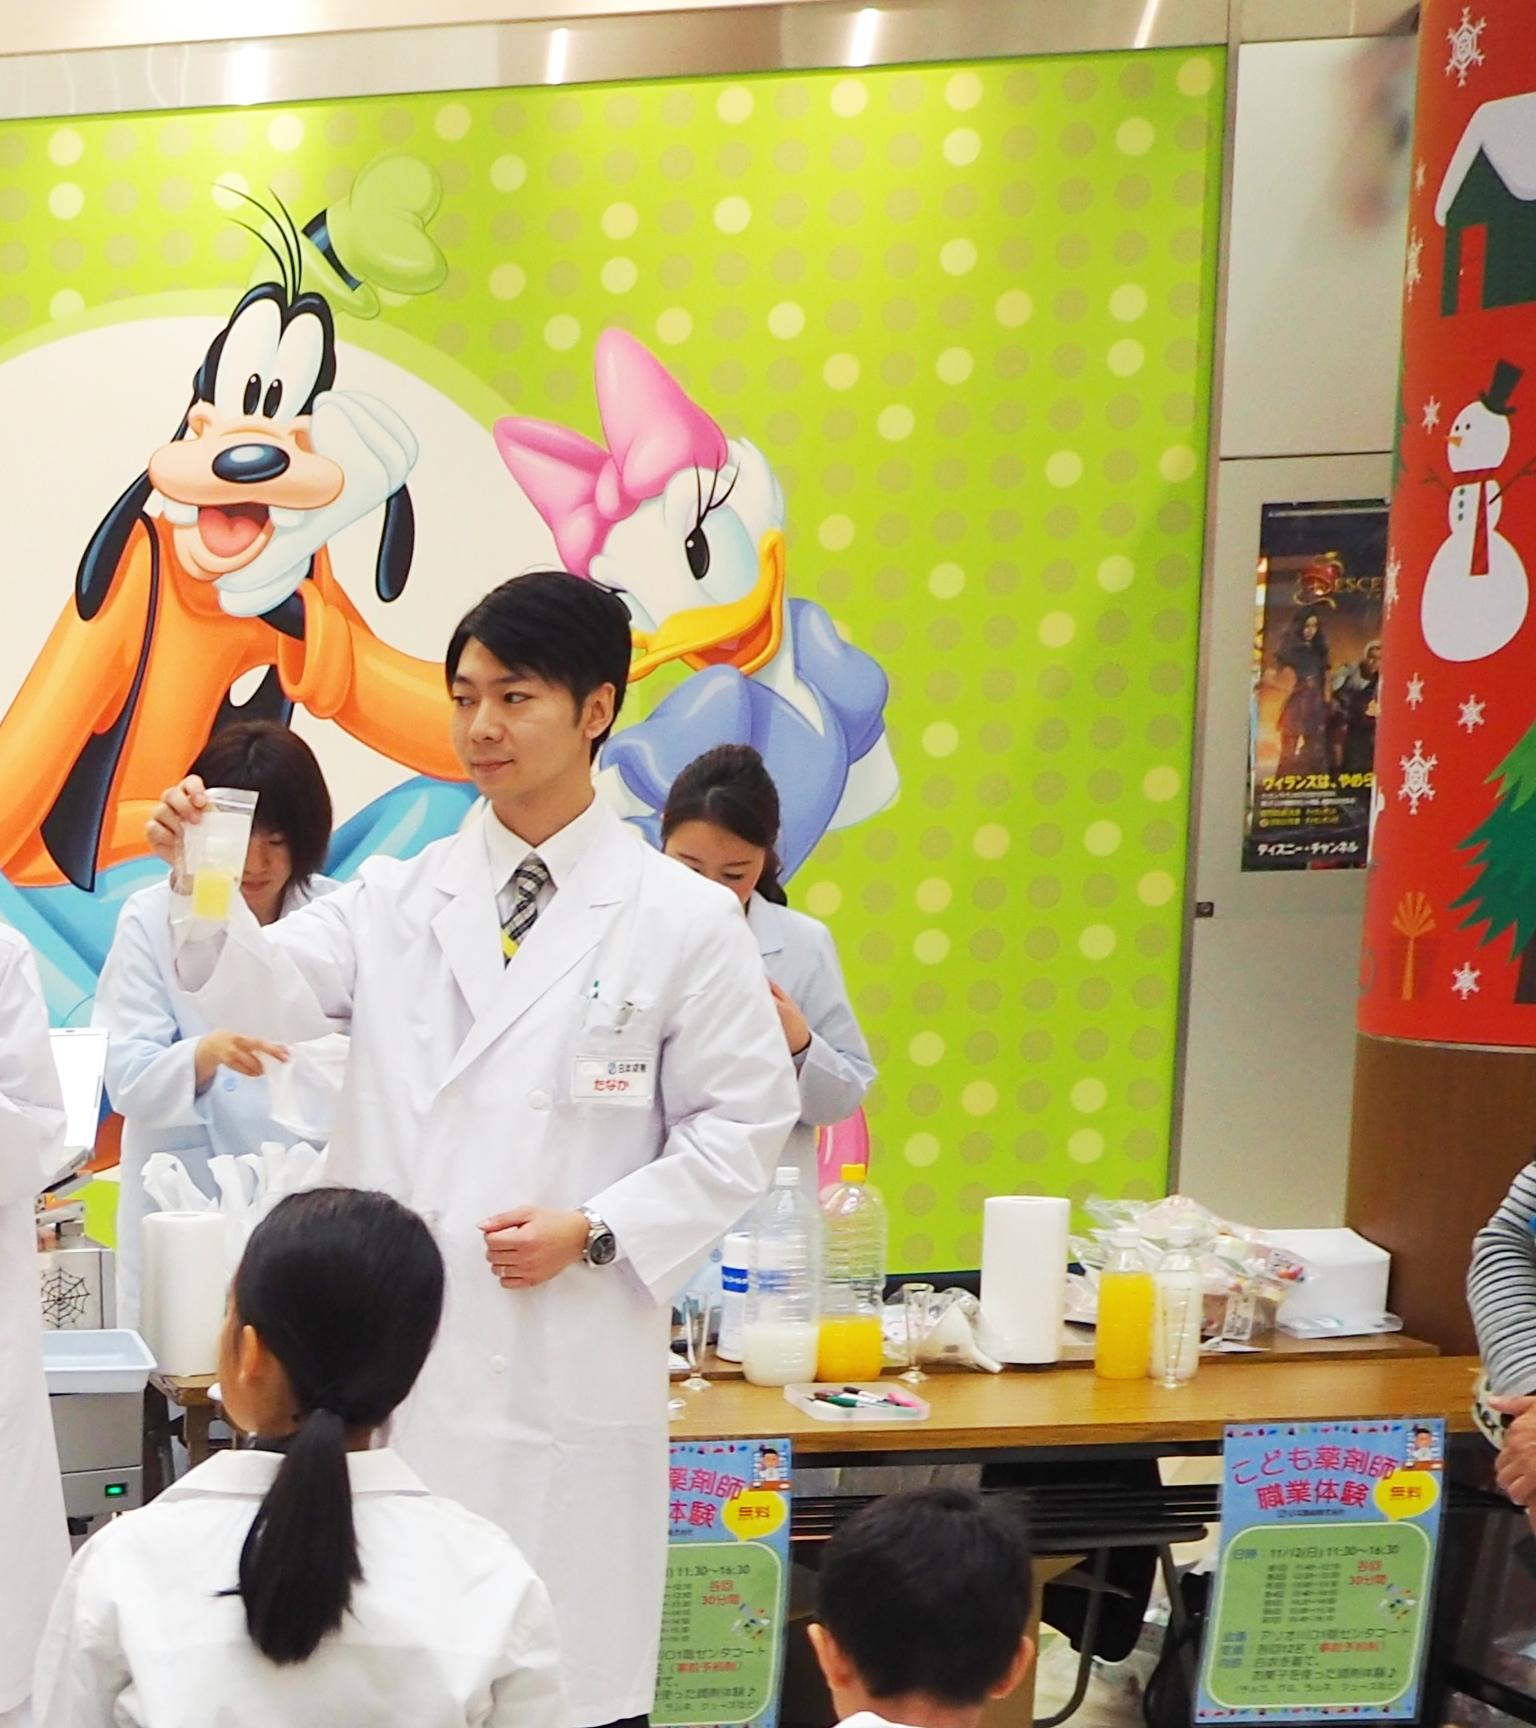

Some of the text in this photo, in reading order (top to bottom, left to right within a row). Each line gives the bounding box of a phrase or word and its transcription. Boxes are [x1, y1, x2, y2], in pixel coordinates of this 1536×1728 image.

[1232, 1445, 1399, 1485] こども薬剤師
[1255, 1479, 1370, 1509] 職業体験
[1389, 1485, 1422, 1501] 無料
[738, 1506, 770, 1520] 無料
